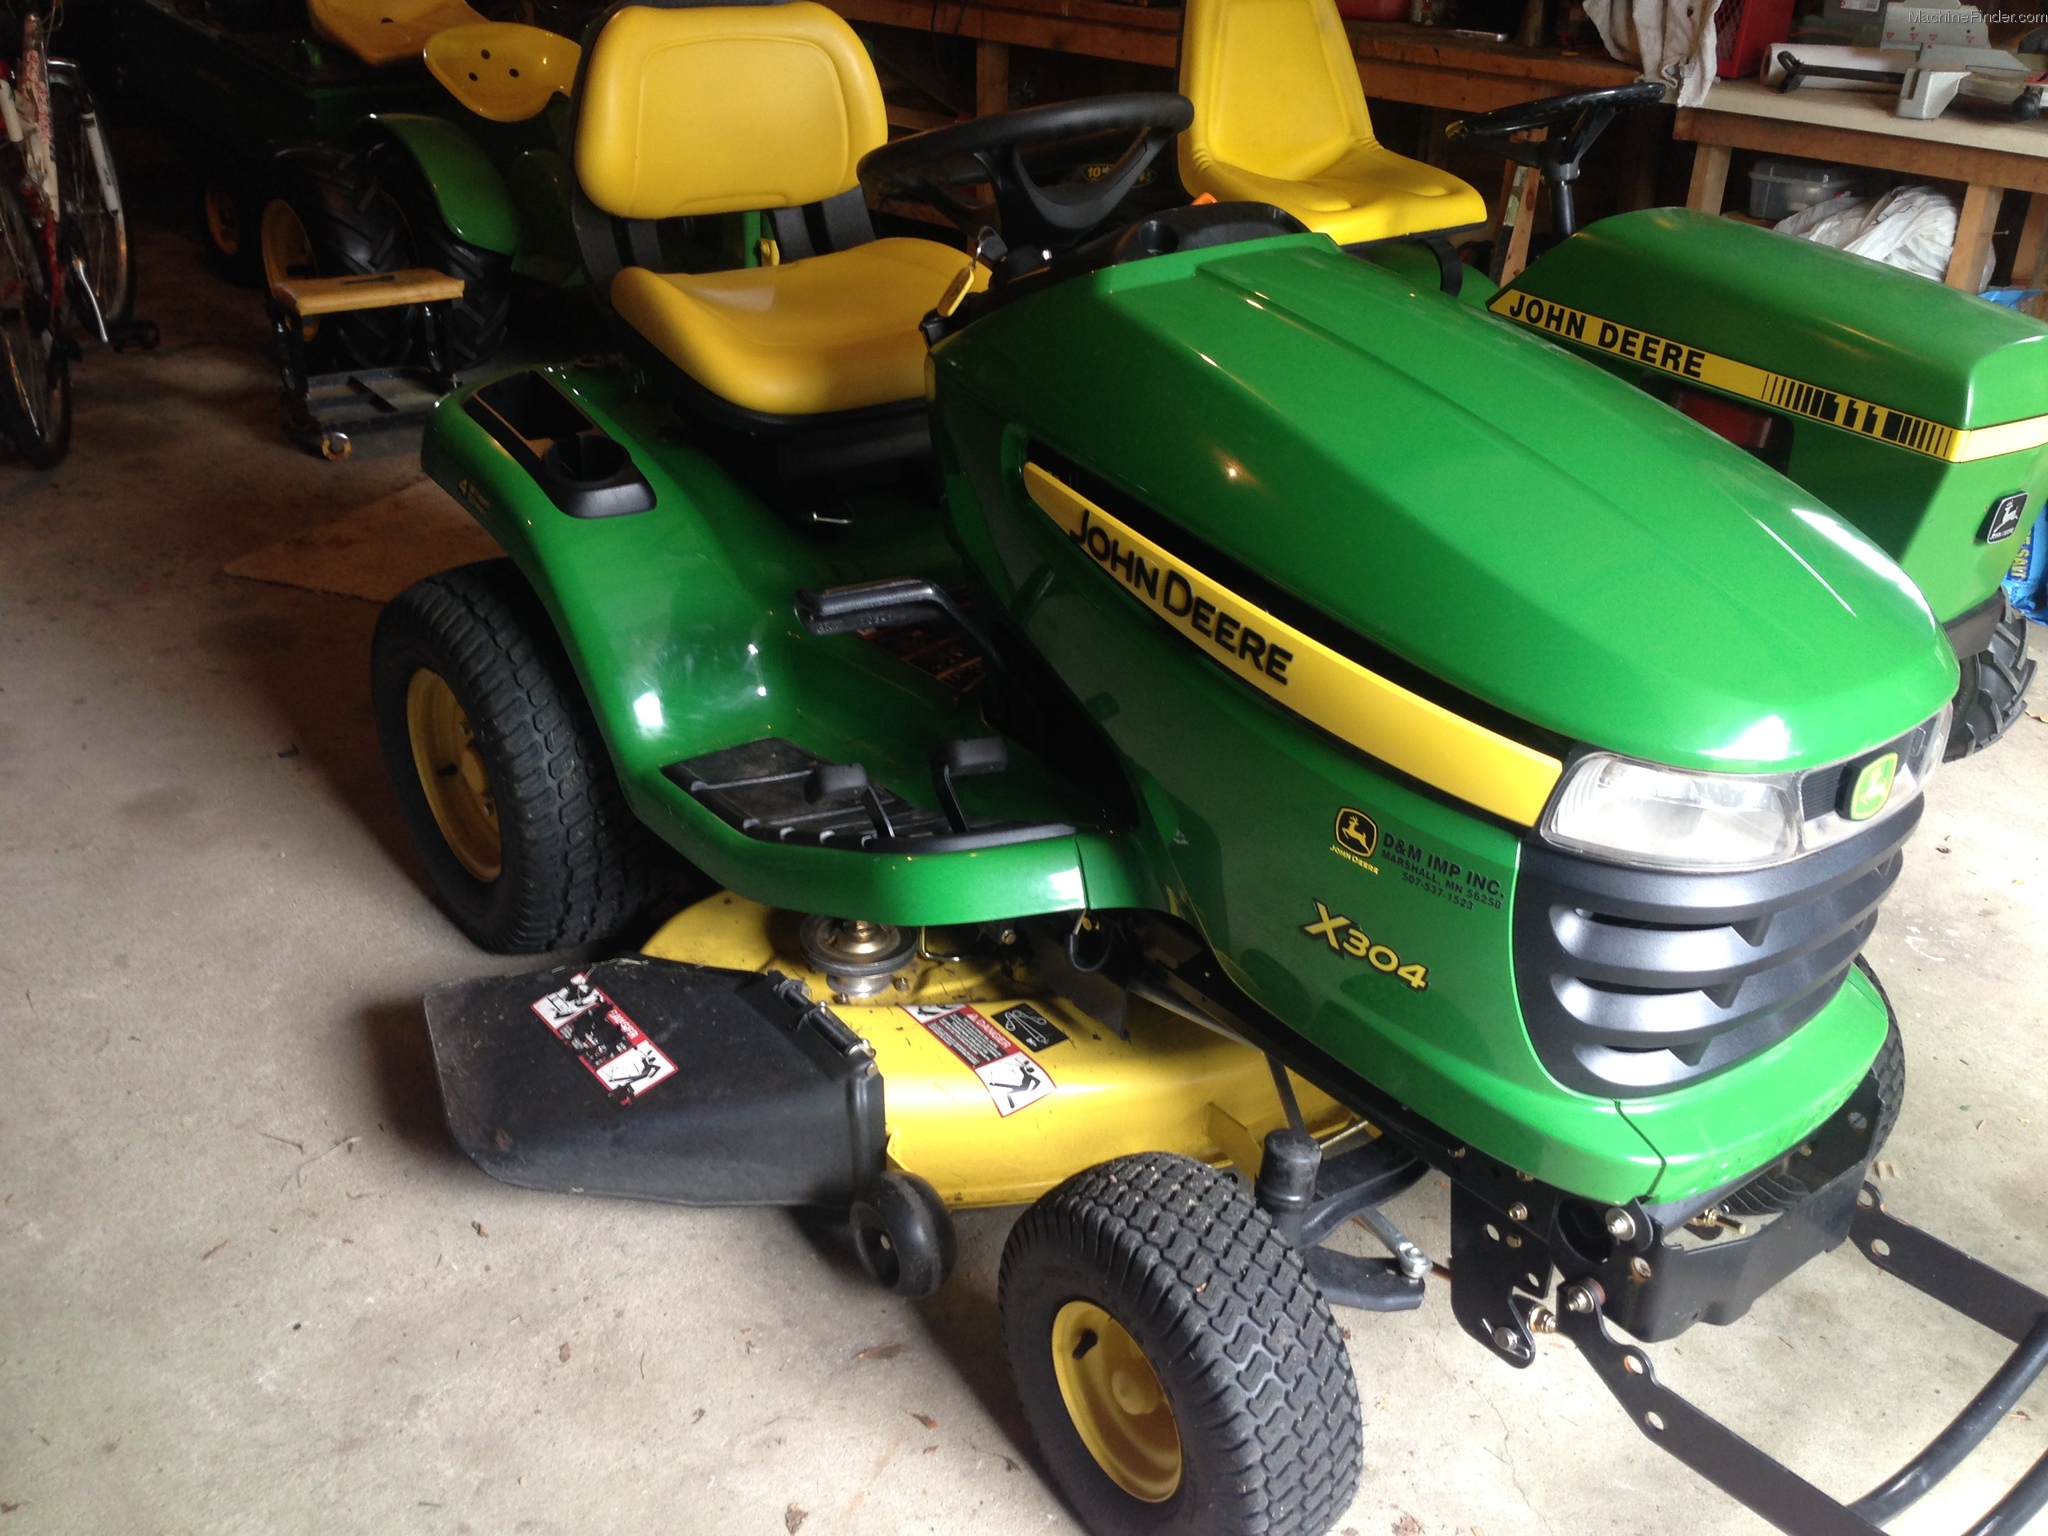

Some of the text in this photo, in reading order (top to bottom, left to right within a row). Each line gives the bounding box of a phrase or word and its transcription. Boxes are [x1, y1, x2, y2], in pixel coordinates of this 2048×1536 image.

[1509, 295, 1705, 378] JOHN DEERE
[1069, 509, 1294, 686] JOHN DEERE
[1329, 844, 1380, 876] JOHN DEERE
[1381, 849, 1502, 910] MARSHALL, MN 56258
[1383, 832, 1506, 899] D&M IMP INC.
[1402, 872, 1475, 911] 507-537-1523
[1301, 898, 1429, 991] X304
[976, 1019, 1012, 1049] DANGER
